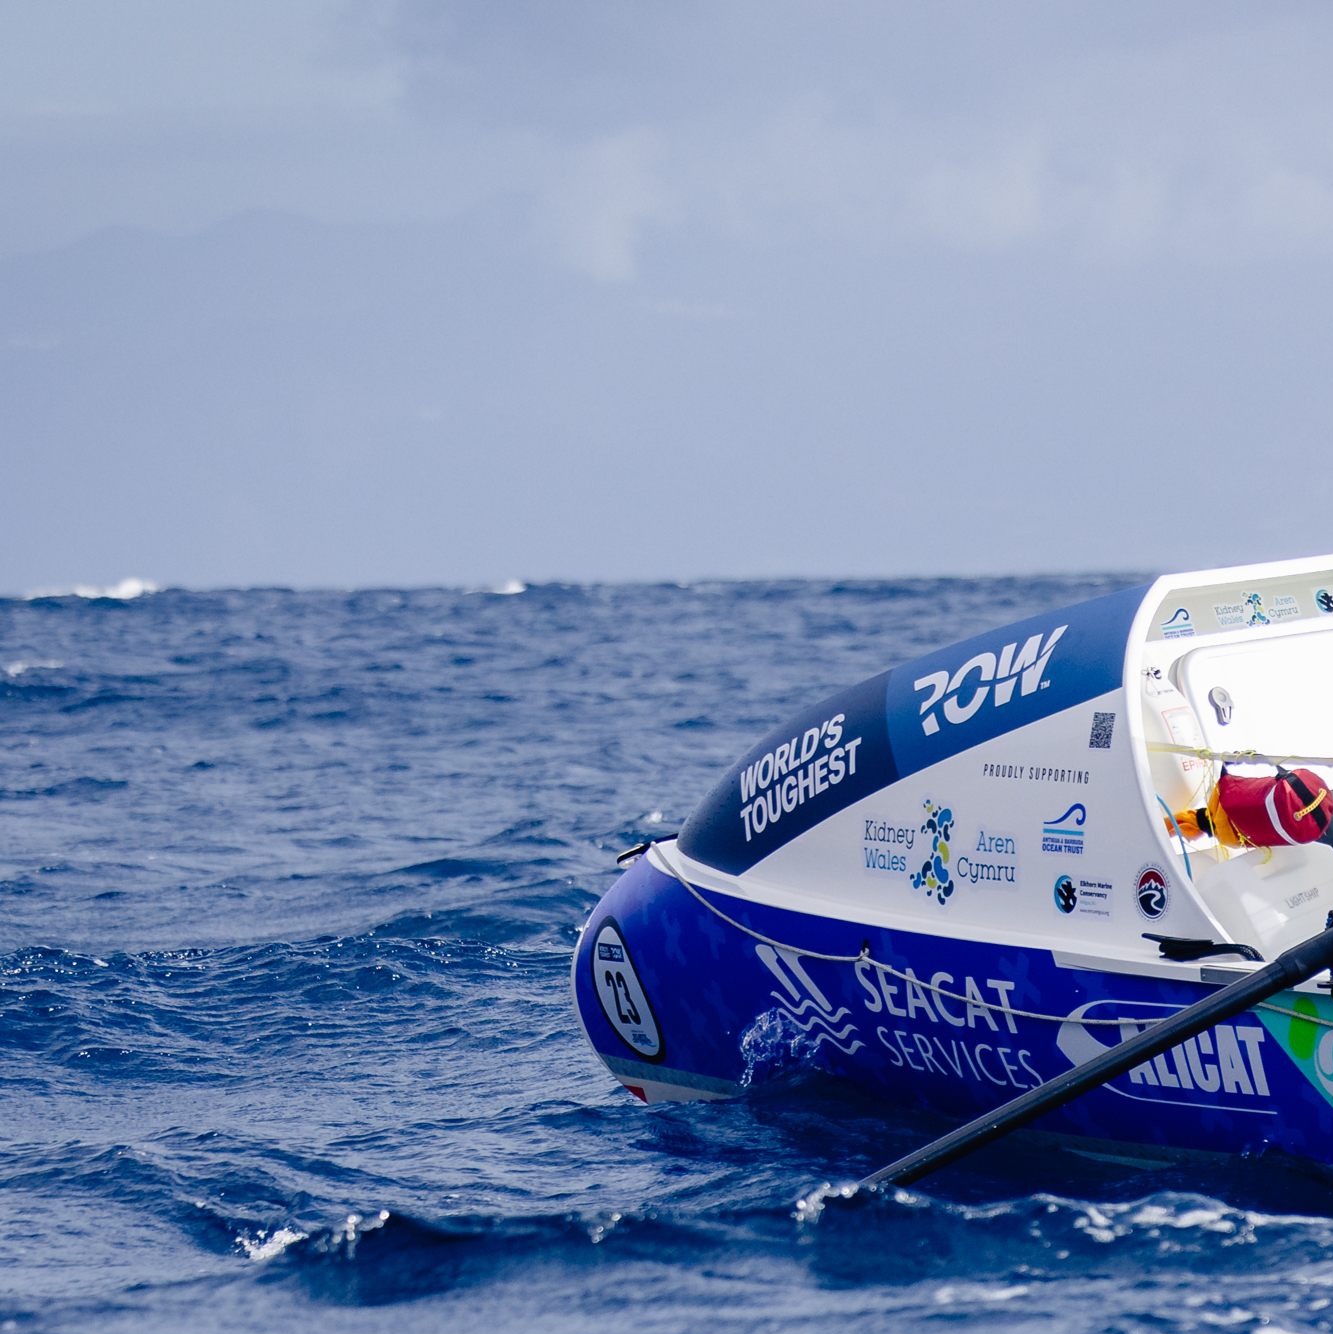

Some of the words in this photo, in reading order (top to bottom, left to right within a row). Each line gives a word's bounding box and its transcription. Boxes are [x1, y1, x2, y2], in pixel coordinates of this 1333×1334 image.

[1214, 604, 1245, 617] Kidney
[1218, 615, 1244, 626] Wales
[1268, 606, 1299, 619] Cymru
[914, 624, 1069, 736] ROW
[740, 713, 846, 803] WORLD'S
[983, 763, 1025, 779] PROUDLY
[1028, 768, 1090, 784] SUPPORTING
[740, 737, 862, 842] TOUGHEST
[864, 820, 915, 849] Kidney
[976, 831, 1016, 854] Aren
[864, 847, 906, 872] Wales
[1042, 844, 1062, 853] OCEAN
[1064, 845, 1084, 854] TRUST
[957, 857, 1016, 883] Cymru
[605, 970, 641, 1025] 23
[855, 961, 1018, 1034] SEACAT
[877, 1026, 1044, 1090] SERVICES
